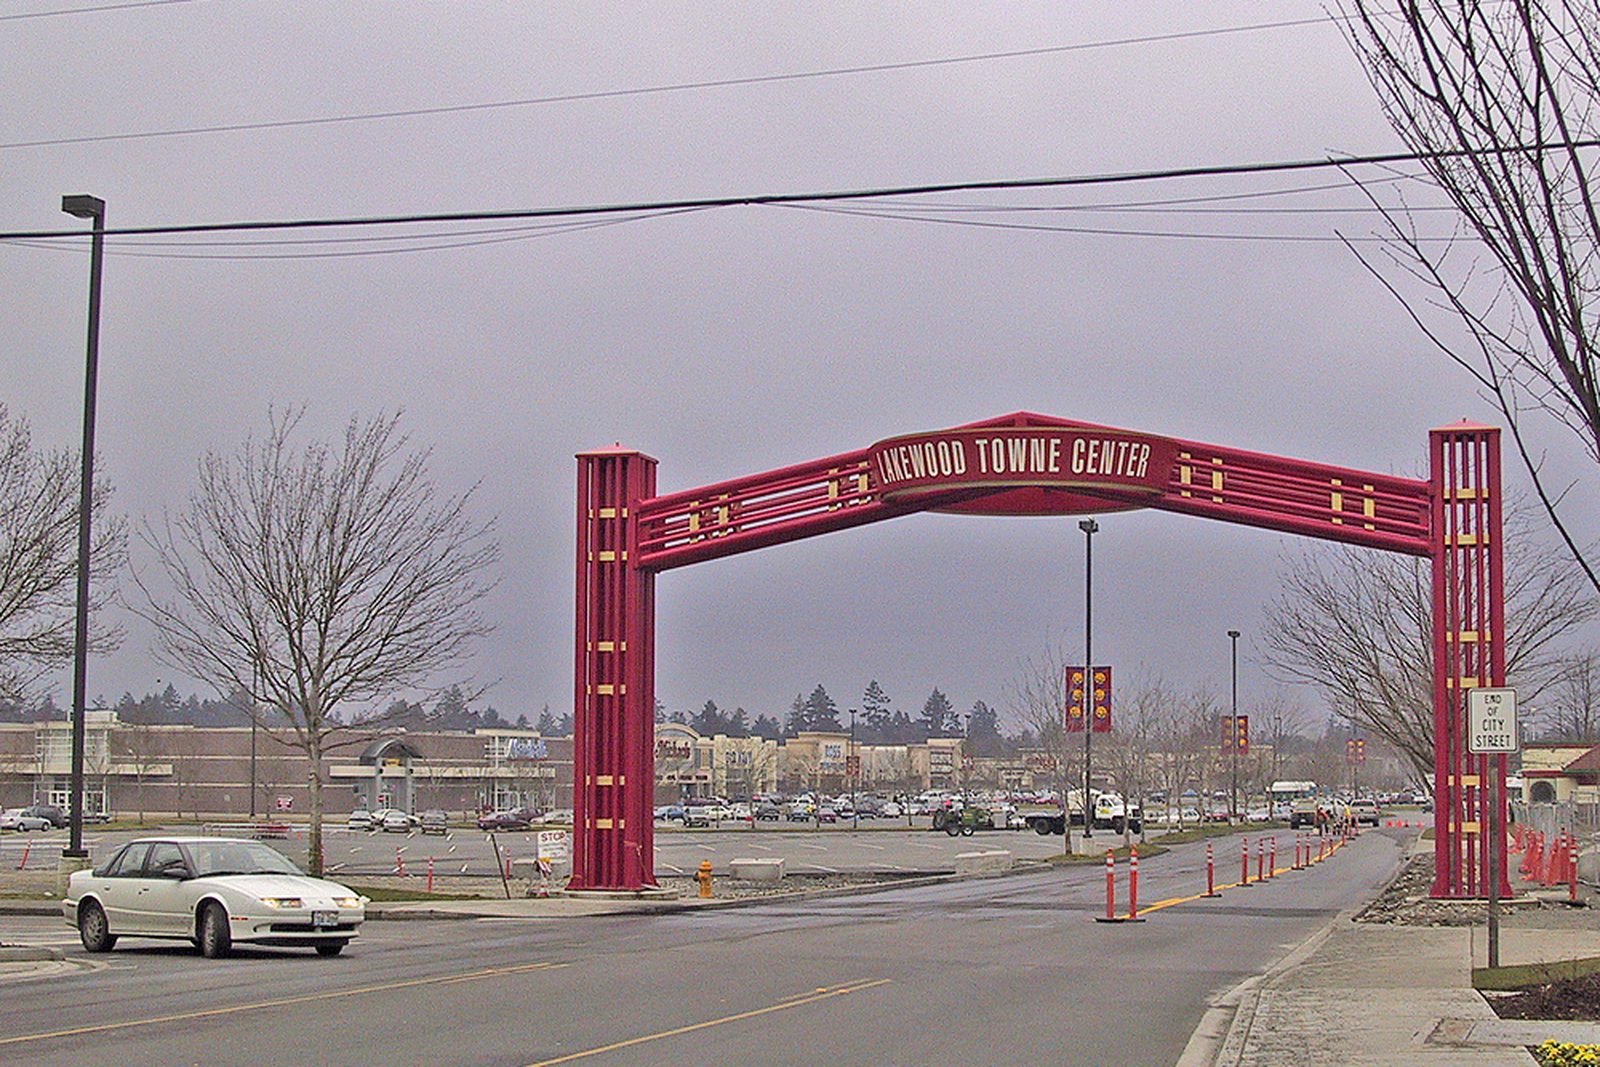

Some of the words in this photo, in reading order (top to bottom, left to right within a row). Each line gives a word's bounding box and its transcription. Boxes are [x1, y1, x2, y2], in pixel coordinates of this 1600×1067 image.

[876, 440, 966, 485] LAKEWOOD
[976, 438, 1061, 474] TOWNE
[1071, 438, 1151, 478] CENTER
[1485, 694, 1502, 704] END
[1487, 706, 1498, 717] OF
[1482, 719, 1504, 731] CITY
[1476, 735, 1510, 747] STREET
[541, 831, 566, 842] STOP
